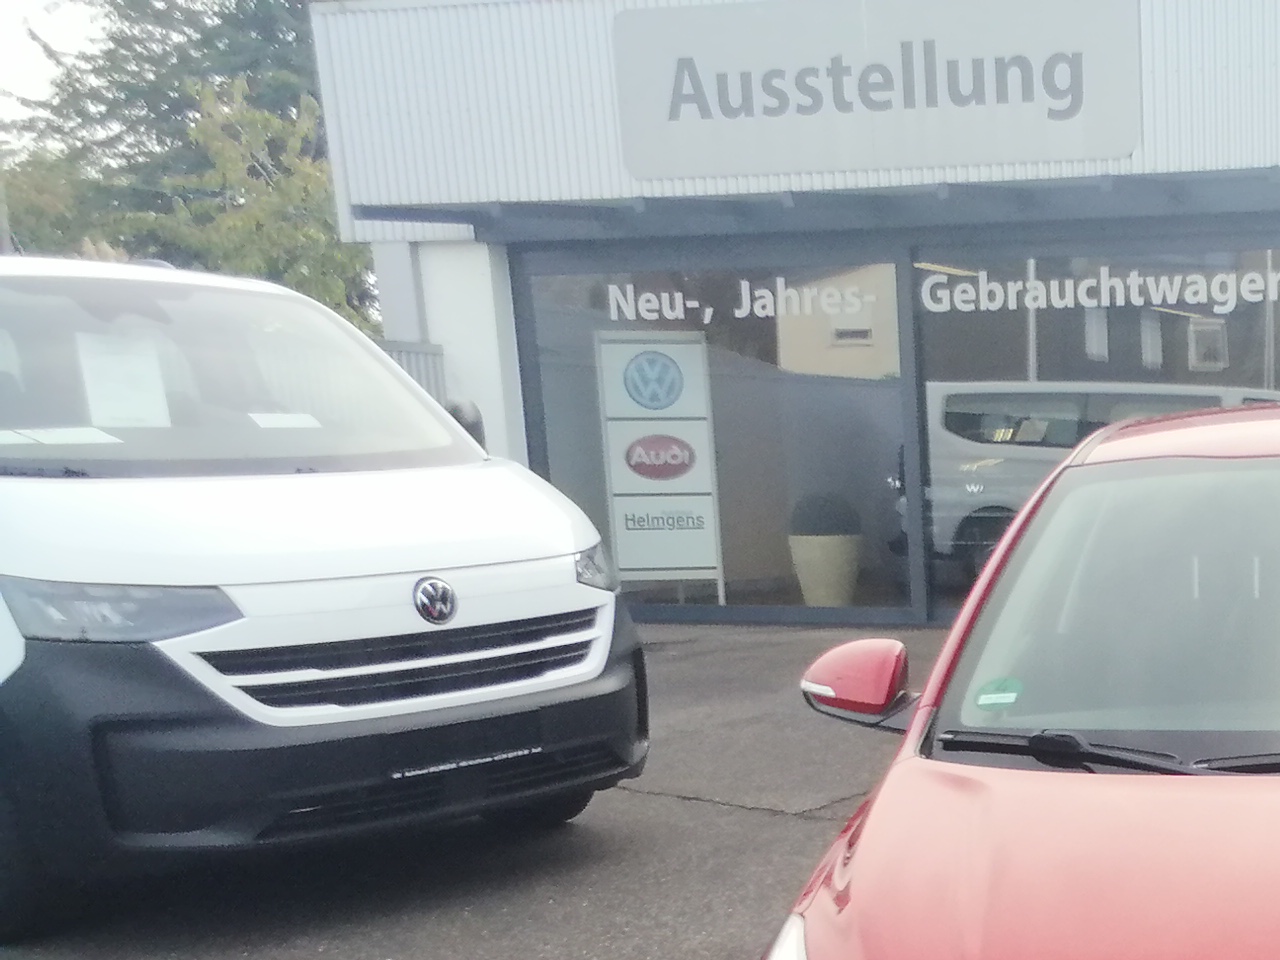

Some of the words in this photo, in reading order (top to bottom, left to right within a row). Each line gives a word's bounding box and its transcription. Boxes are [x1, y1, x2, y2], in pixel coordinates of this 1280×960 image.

[668, 39, 1083, 121] Ausstellung
[608, 284, 713, 324] Neu-,
[734, 277, 877, 319] Jahres-
[630, 446, 689, 466] Audi
[625, 513, 704, 531] Helmgens
